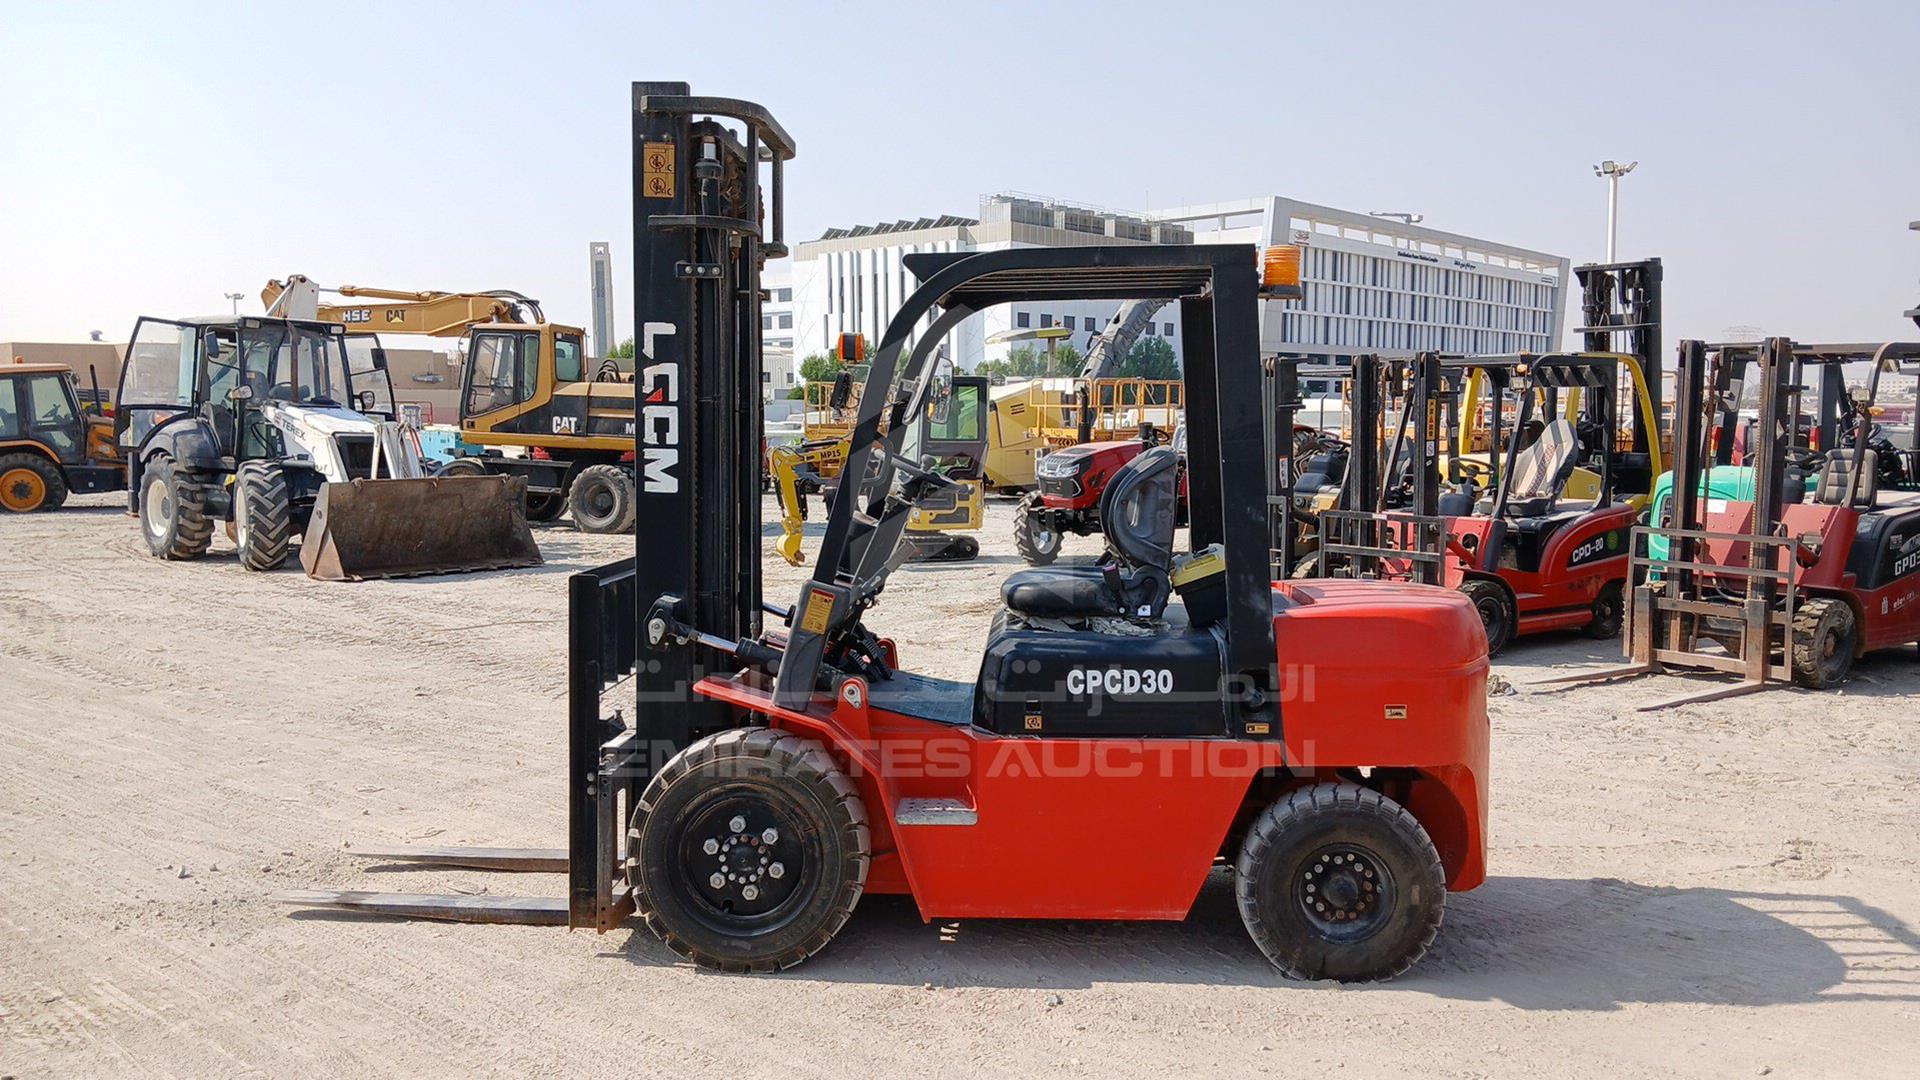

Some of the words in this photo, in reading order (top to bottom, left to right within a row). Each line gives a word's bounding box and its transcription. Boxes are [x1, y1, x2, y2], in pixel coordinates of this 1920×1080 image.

[342, 309, 372, 323] HSE
[386, 309, 406, 323] CAT
[282, 418, 308, 440] TEREX
[552, 415, 578, 434] CAT
[1572, 536, 1604, 563] CPD-20
[1066, 668, 1174, 696] CPCD30
